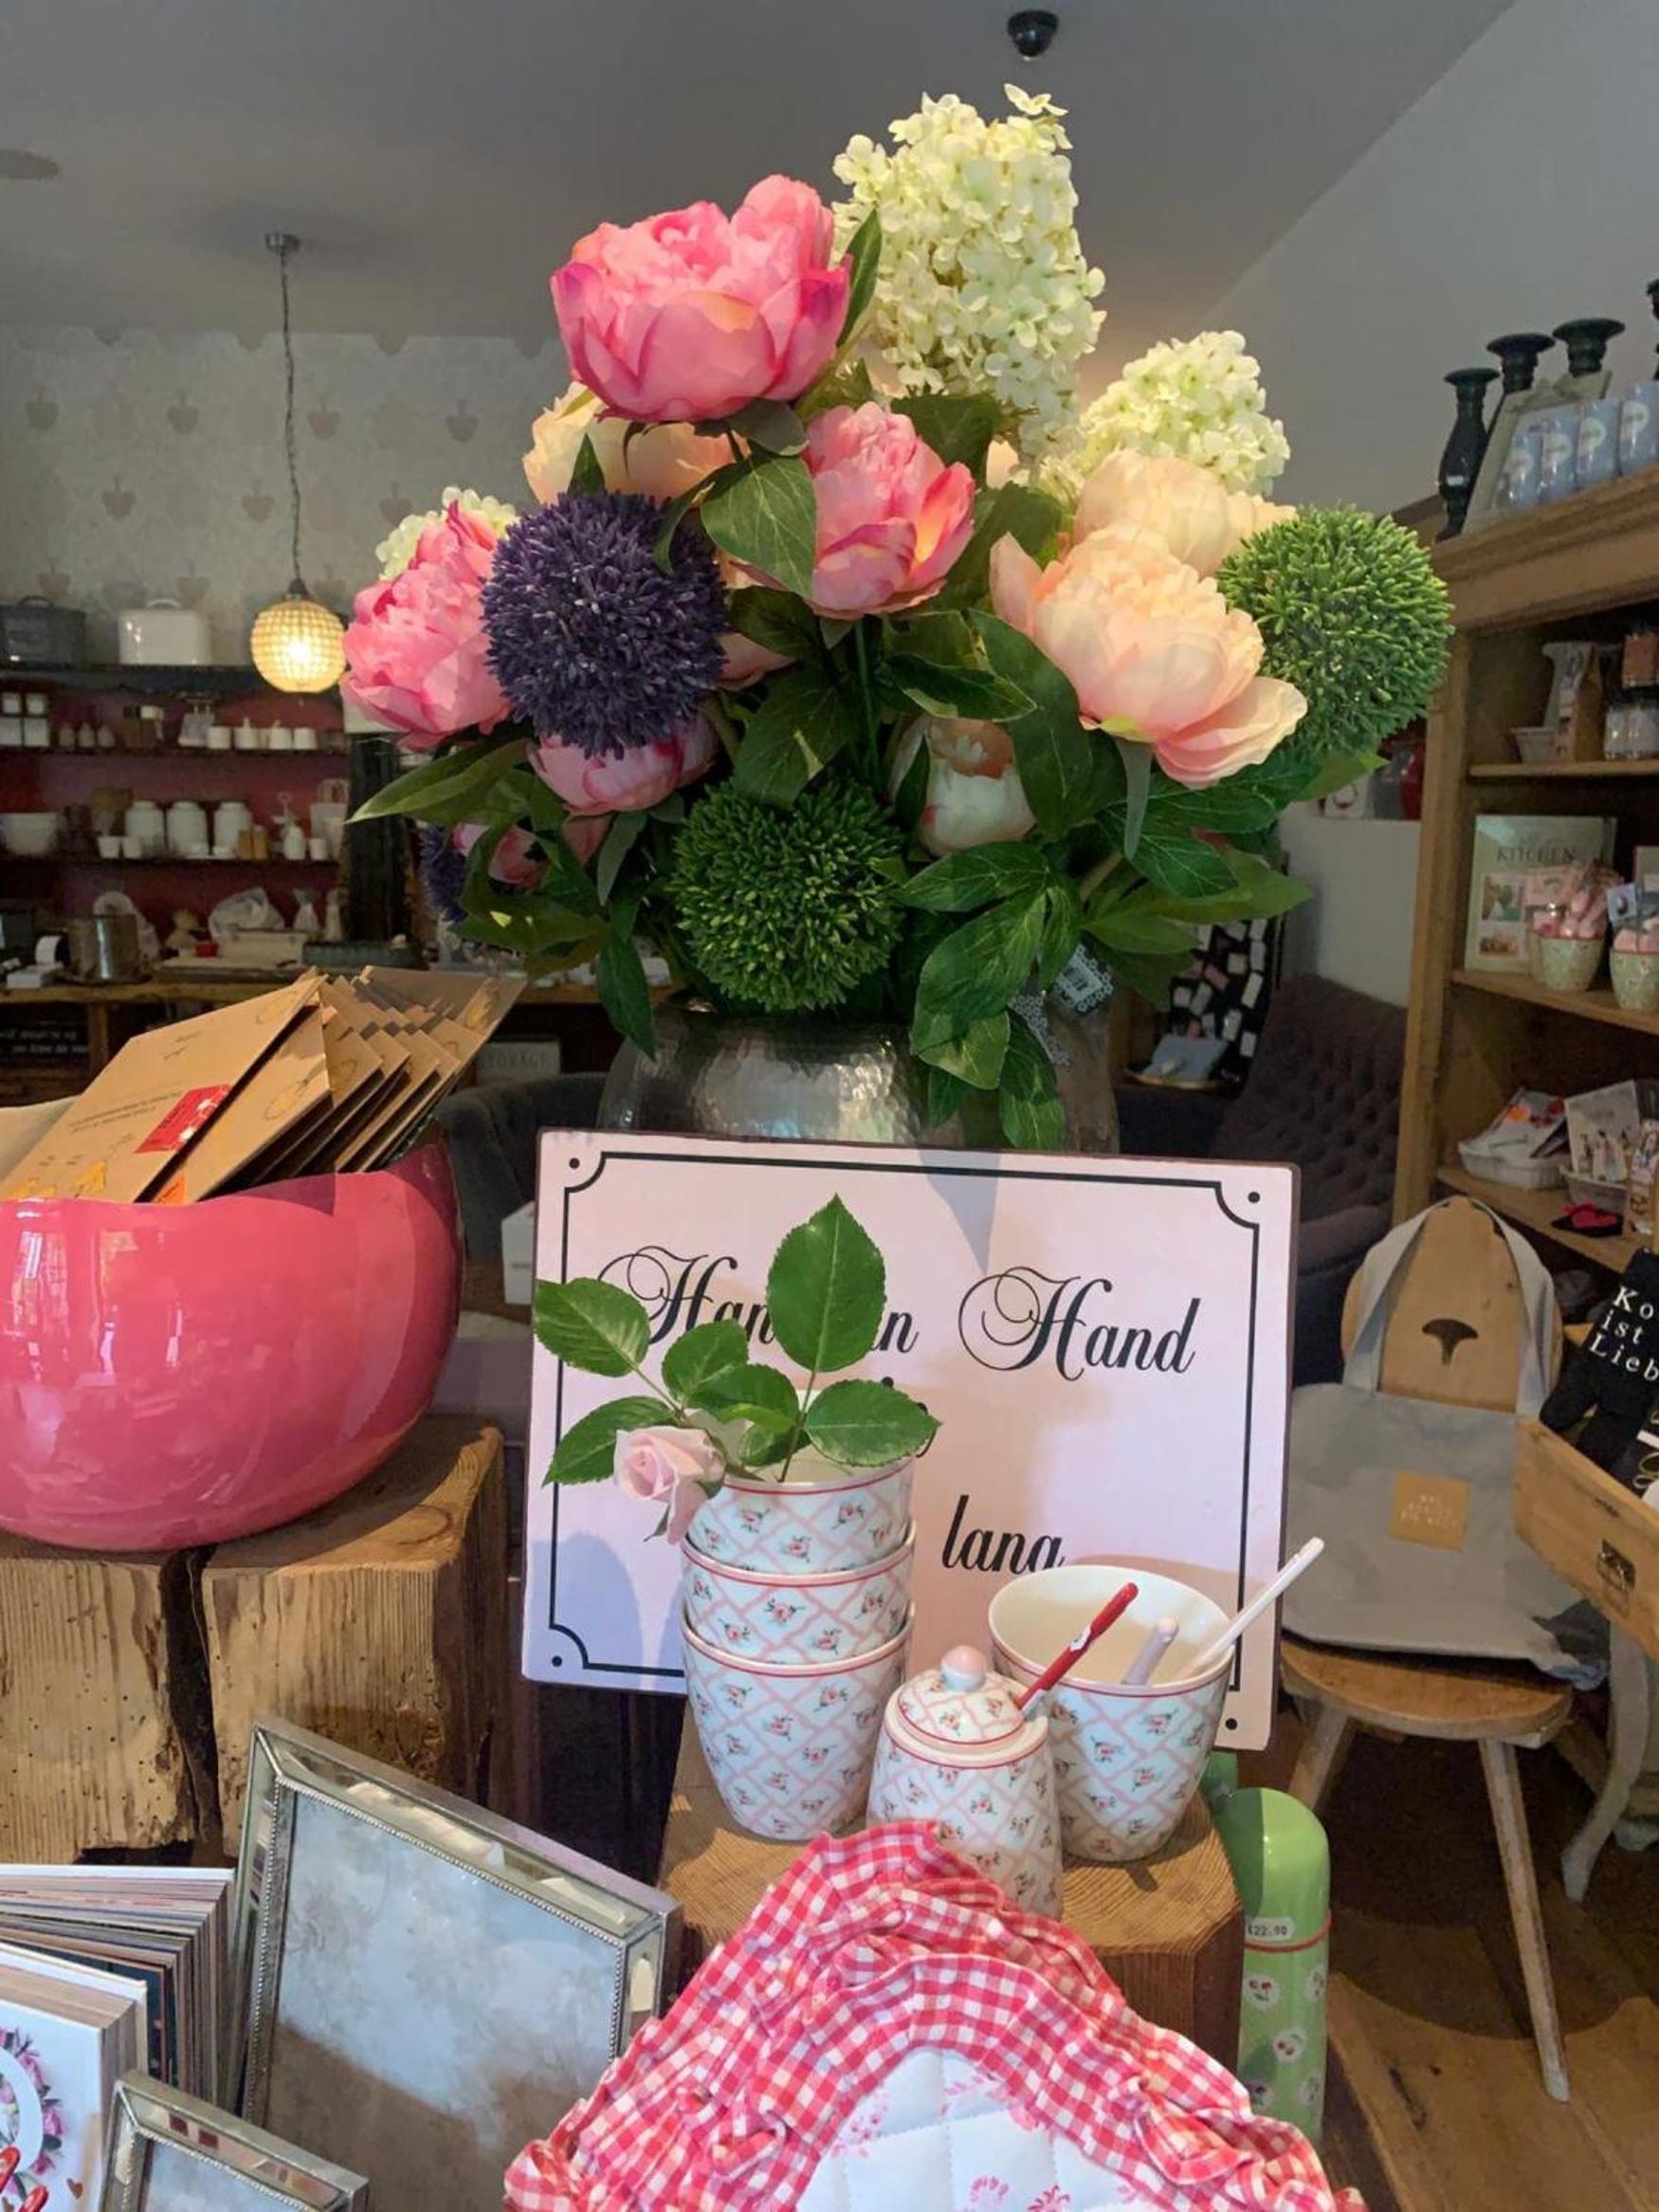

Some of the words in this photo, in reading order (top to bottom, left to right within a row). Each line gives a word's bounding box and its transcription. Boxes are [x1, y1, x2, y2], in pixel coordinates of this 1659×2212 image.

[597, 1245, 777, 1345] Han
[871, 1309, 920, 1354] n
[958, 1266, 1202, 1381] Hand
[1601, 1309, 1643, 1344] ist
